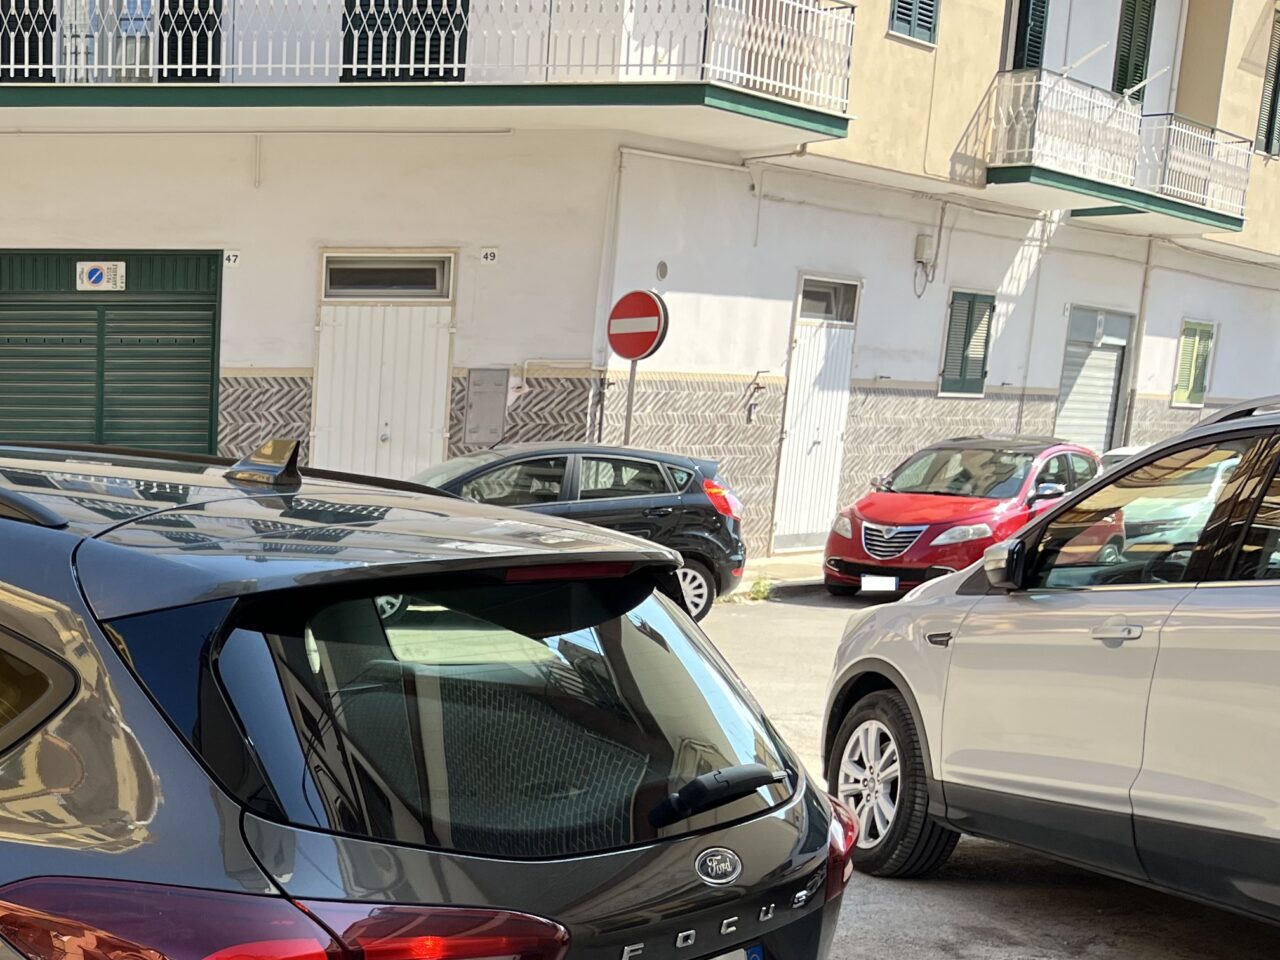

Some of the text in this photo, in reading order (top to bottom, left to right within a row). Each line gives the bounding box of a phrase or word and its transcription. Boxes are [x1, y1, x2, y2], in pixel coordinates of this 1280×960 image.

[225, 254, 239, 264] 47
[483, 252, 496, 261] 49
[706, 855, 733, 877] Ford
